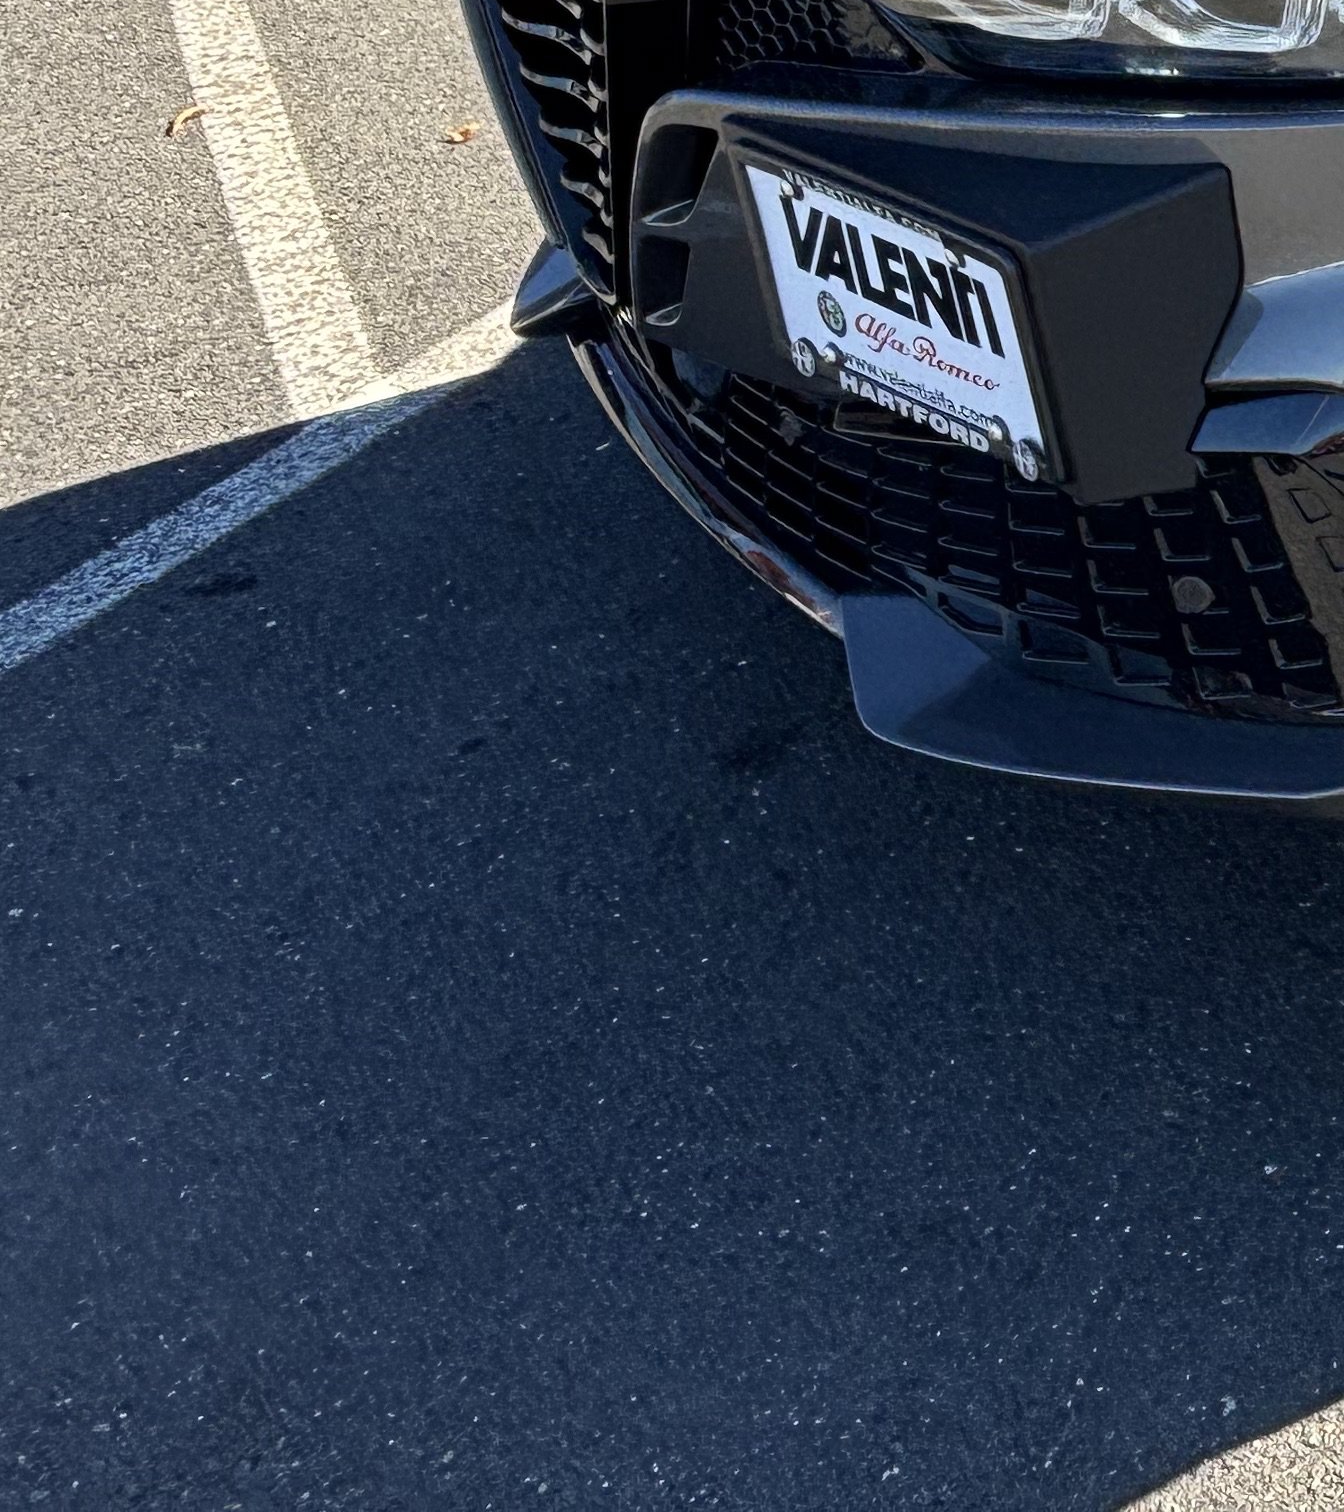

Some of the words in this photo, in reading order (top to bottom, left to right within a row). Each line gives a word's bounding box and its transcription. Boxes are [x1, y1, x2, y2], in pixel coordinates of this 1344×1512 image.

[780, 193, 1005, 359] VALENTI
[855, 313, 911, 355] Alfa
[913, 337, 1000, 390] Romeo
[839, 371, 989, 452] HARTFORD
